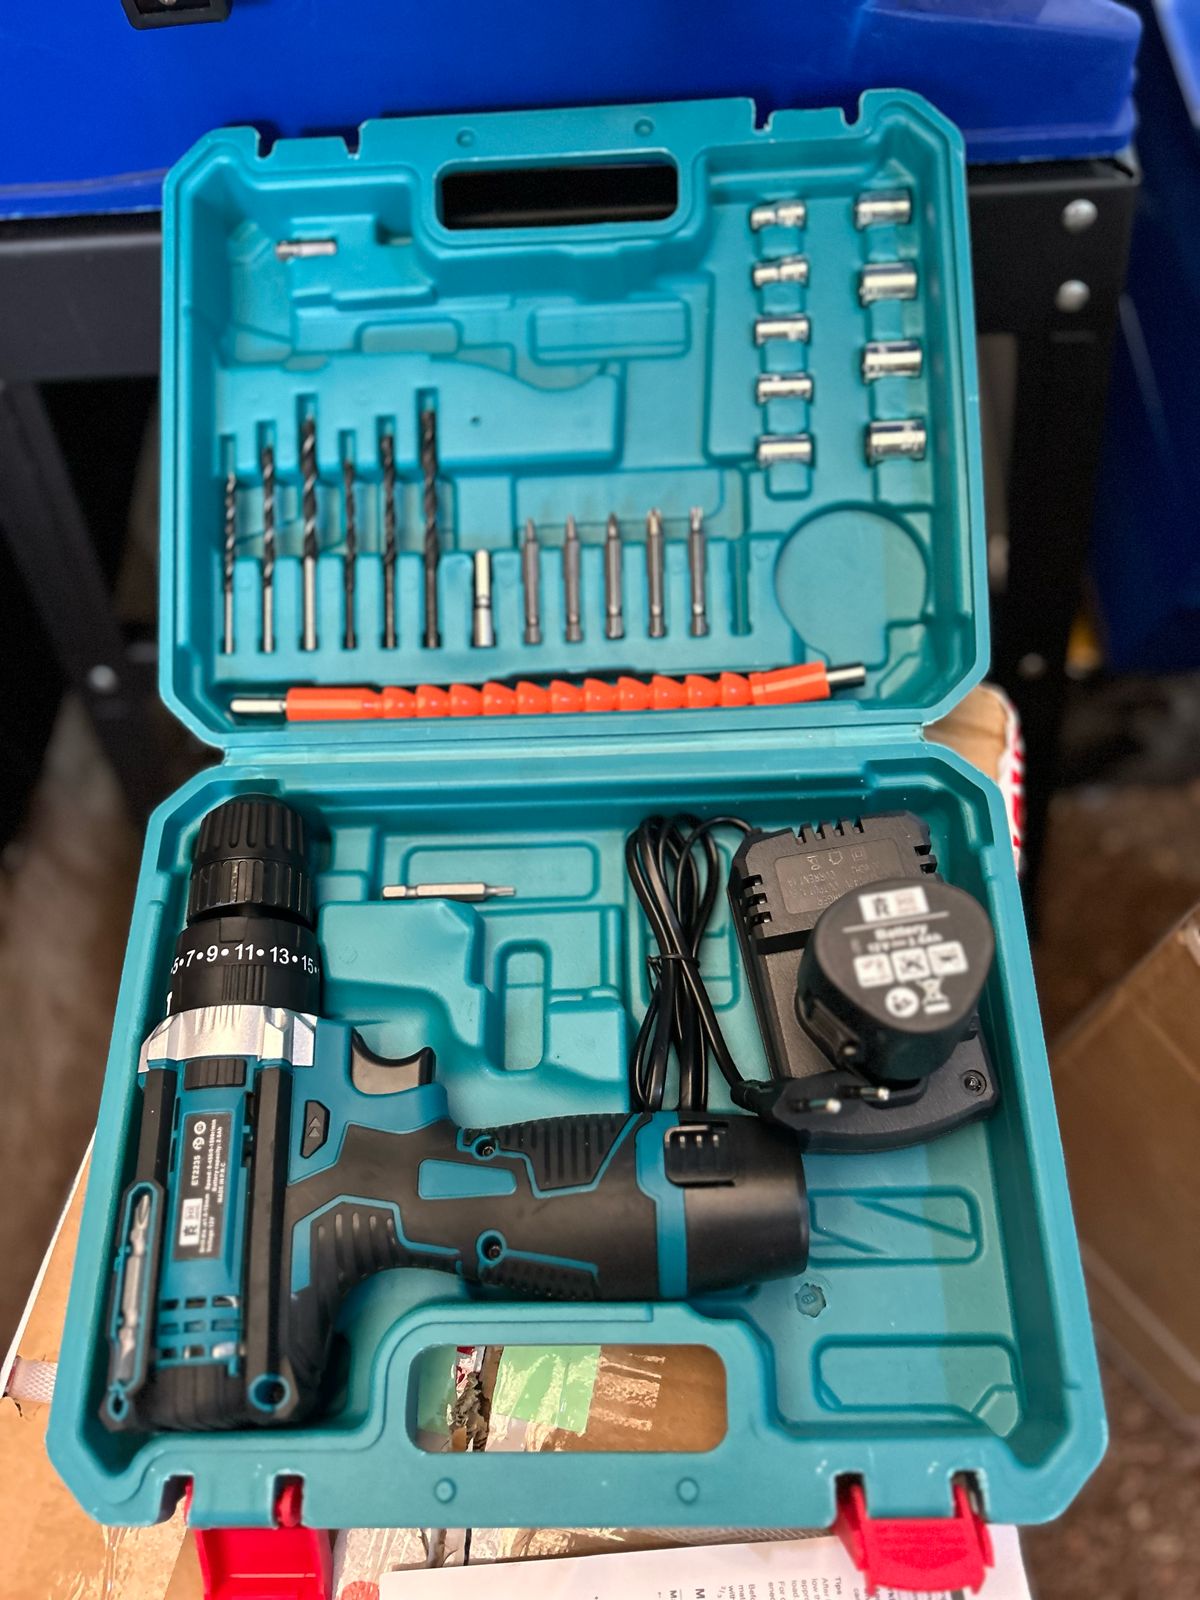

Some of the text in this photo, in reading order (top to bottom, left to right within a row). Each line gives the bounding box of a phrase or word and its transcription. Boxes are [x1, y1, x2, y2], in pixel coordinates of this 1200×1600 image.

[186, 949, 196, 967] 7
[206, 945, 219, 963] 9
[234, 943, 255, 961] 11
[269, 946, 290, 965] 13
[301, 955, 315, 974] 15
[822, 1577, 830, 1597] After
[834, 1576, 842, 1595] Tips
